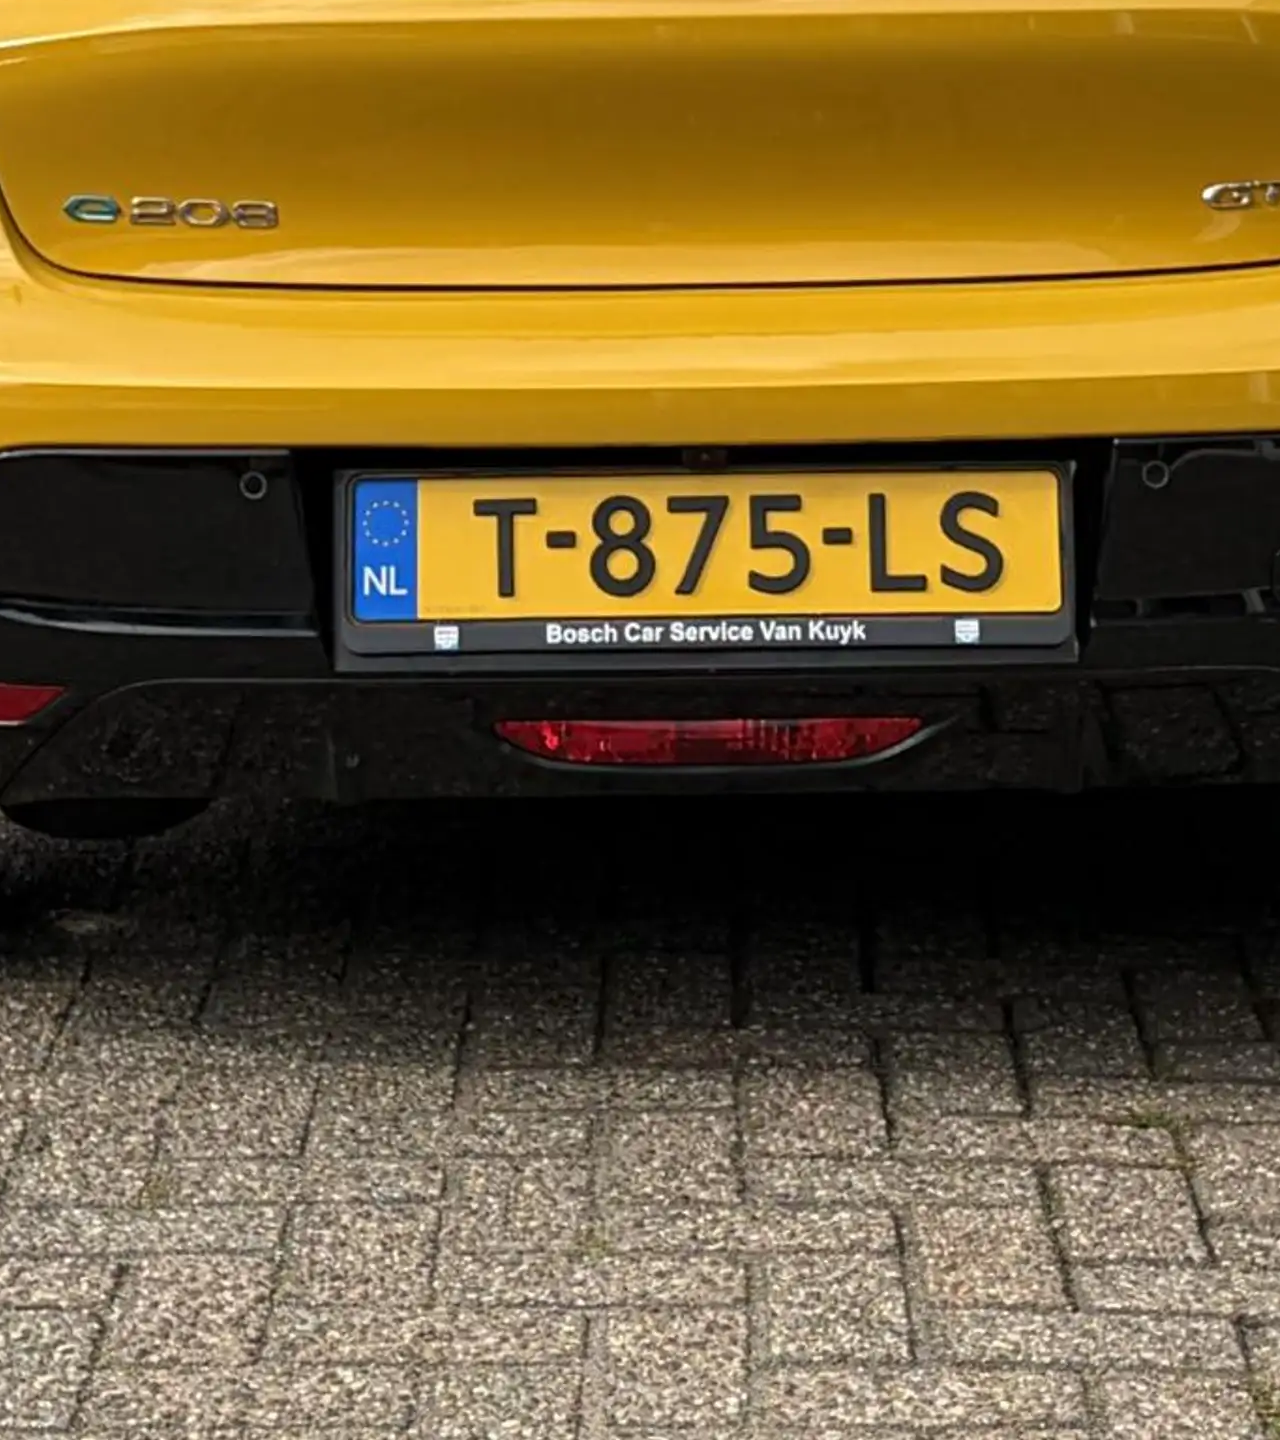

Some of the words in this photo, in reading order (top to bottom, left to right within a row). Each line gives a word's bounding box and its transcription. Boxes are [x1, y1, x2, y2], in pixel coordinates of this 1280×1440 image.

[473, 491, 1004, 598] T-875-LS
[363, 564, 408, 596] NL
[545, 622, 618, 645] Bosch
[624, 622, 664, 643] Car
[670, 621, 753, 643] Service
[759, 621, 802, 642] Van
[808, 619, 867, 646] Kuyk
